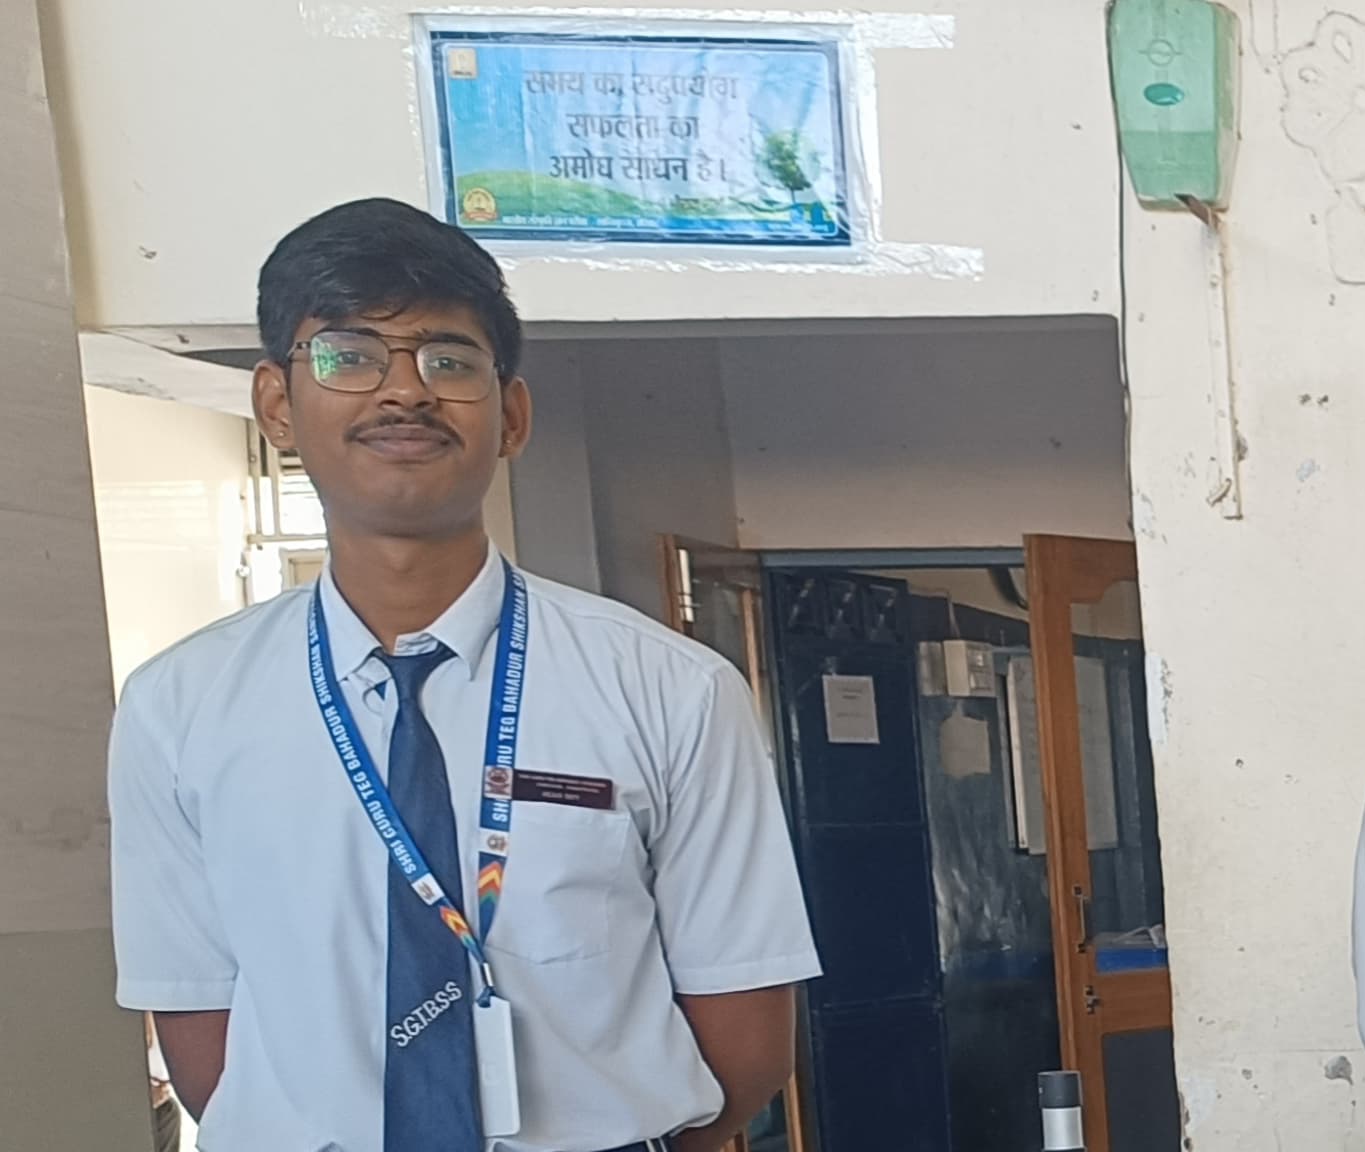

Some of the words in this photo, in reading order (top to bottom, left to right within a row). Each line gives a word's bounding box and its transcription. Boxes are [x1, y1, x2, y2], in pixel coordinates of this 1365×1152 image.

[525, 70, 585, 95] समय
[592, 72, 625, 96] का
[566, 113, 660, 139] सफलता
[667, 115, 700, 140] का
[550, 147, 614, 181] अमोघ
[620, 155, 688, 182] साधन
[510, 590, 526, 650] SHIKSHAN
[309, 644, 333, 708] SHIKSHAN
[324, 706, 360, 770] BAHADUR
[353, 772, 374, 799] TEG
[367, 800, 396, 838] GURU
[390, 840, 416, 874] SHRI
